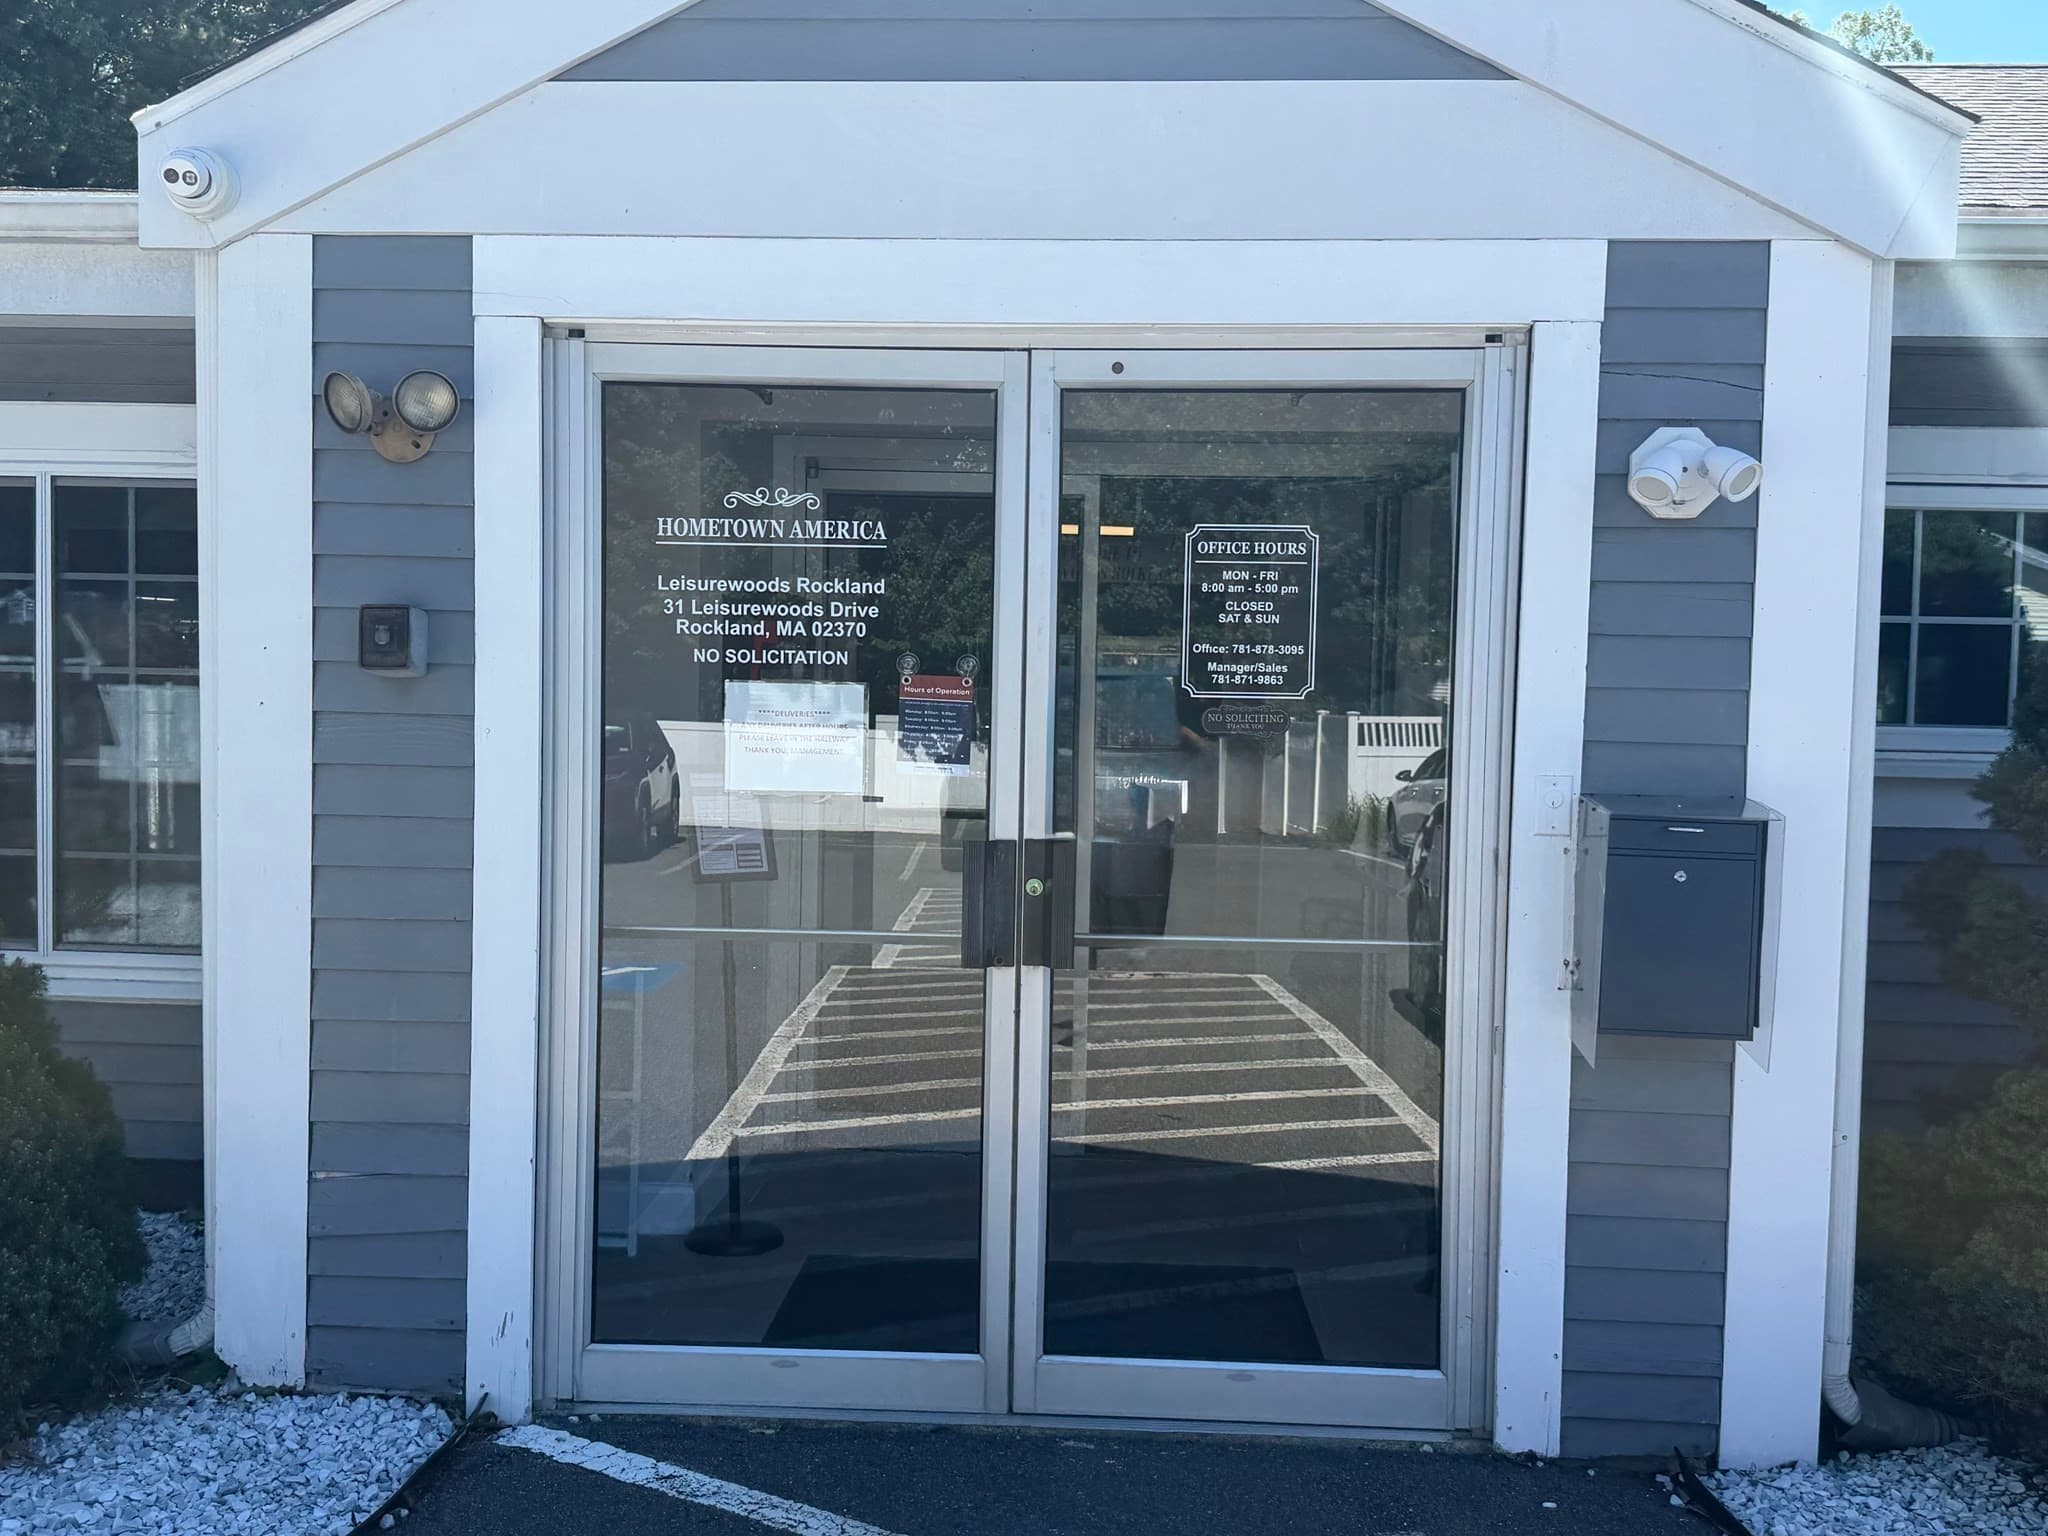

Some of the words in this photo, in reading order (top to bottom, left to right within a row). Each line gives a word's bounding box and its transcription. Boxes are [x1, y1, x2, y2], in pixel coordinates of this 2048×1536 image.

[656, 517, 785, 539] HOMETOWN
[789, 519, 887, 541] AMERICA
[1197, 540, 1251, 555] OFFICE
[1253, 542, 1307, 556] HOURS
[1222, 570, 1249, 581] MON
[1259, 571, 1279, 581] FRI
[657, 575, 791, 593] Leisurewoods
[796, 577, 886, 595] Rockland
[1201, 583, 1225, 593] 8:00
[1227, 585, 1245, 593] am
[1255, 583, 1278, 594] 5:00
[1280, 585, 1298, 596] pm
[663, 598, 684, 615] 31
[690, 599, 824, 618] Leisurewoods
[830, 602, 880, 619] Drive
[1225, 601, 1274, 612] CLOSED
[1218, 613, 1241, 624] SAT
[1243, 614, 1253, 624] &
[1255, 614, 1280, 624] SUN
[675, 619, 770, 639] Rockland,
[776, 620, 807, 637] MA
[811, 620, 867, 638] 02370
[1192, 643, 1229, 655] Office:
[1232, 644, 1305, 656] 781-878-3095
[693, 648, 721, 664] NO
[725, 648, 849, 666] SOLICITATION
[1207, 662, 1288, 674] Manager/Sales
[1211, 675, 1284, 685] 781-871-9863
[935, 687, 970, 695] Operation
[1207, 713, 1223, 722] NO
[1224, 713, 1284, 723] SOLICITING
